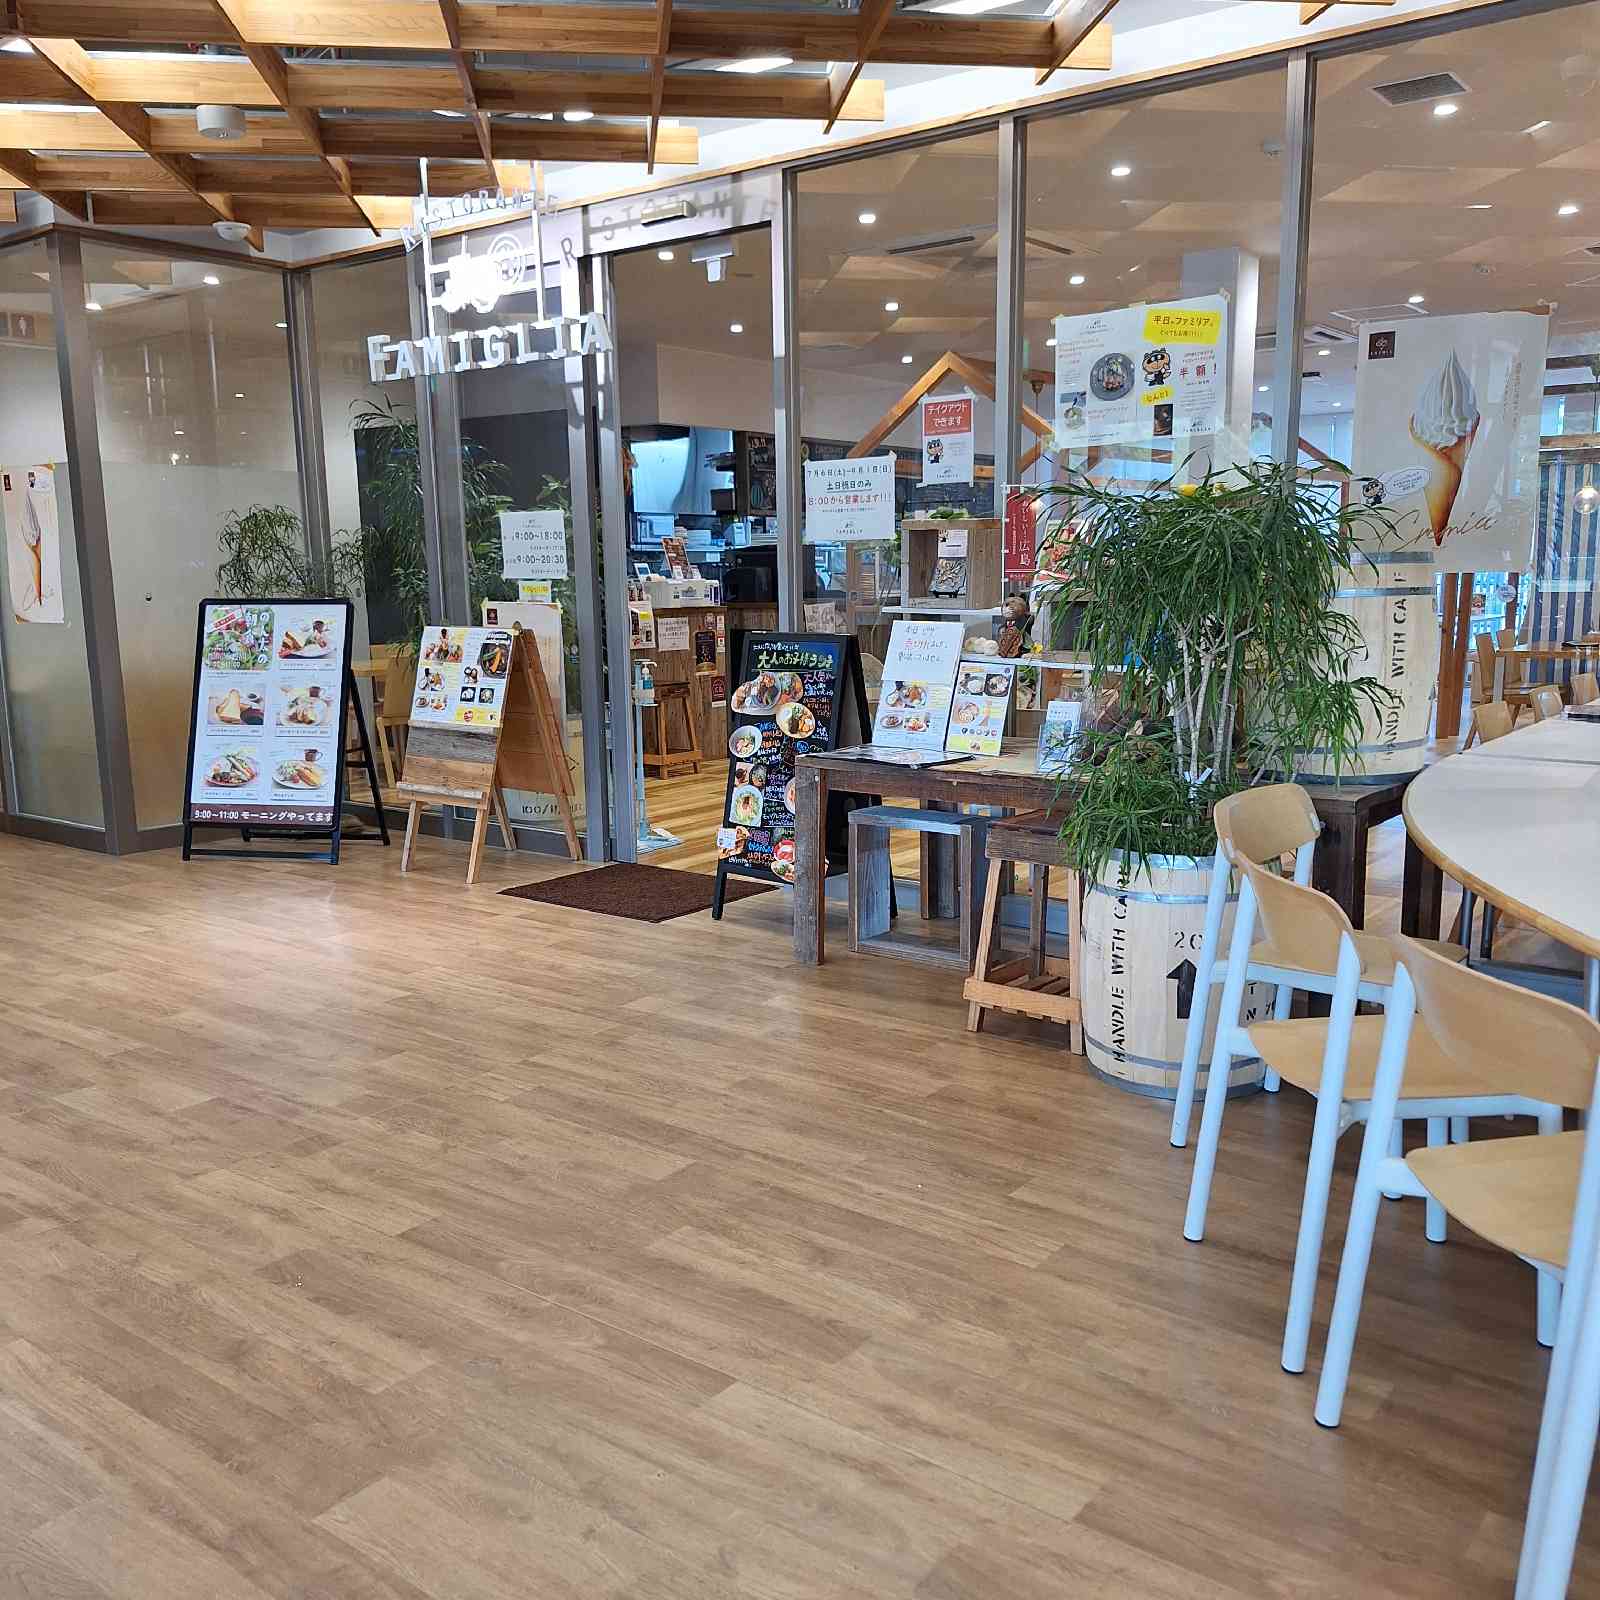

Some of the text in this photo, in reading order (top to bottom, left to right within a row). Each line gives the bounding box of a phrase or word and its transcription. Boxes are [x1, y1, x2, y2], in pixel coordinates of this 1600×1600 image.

[367, 311, 613, 383] FAMIGLIA
[927, 402, 968, 414] テイクアウト
[934, 416, 962, 427] できます
[826, 479, 872, 490] 土日祝日のみ
[1392, 571, 1408, 624] CAE
[1391, 632, 1407, 679] WITH
[1111, 927, 1127, 975] WITH
[1111, 985, 1126, 1064] HANDLE
